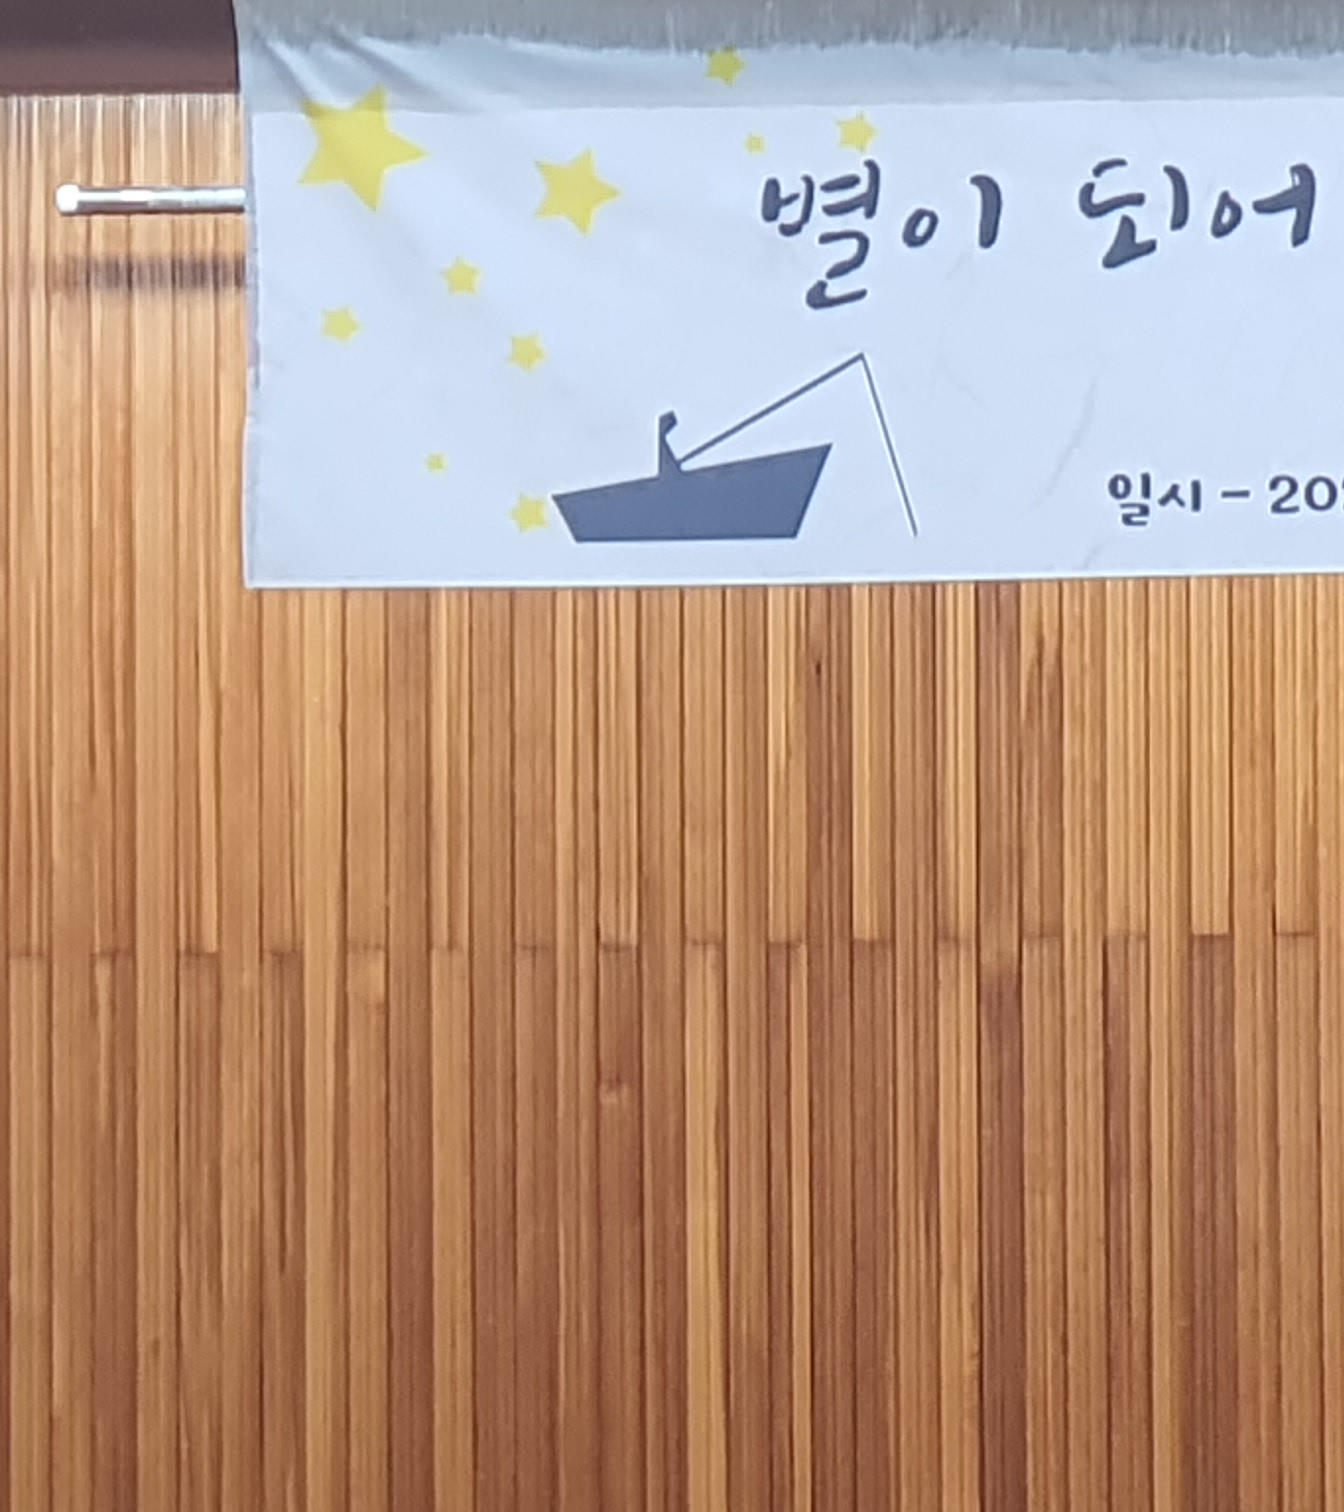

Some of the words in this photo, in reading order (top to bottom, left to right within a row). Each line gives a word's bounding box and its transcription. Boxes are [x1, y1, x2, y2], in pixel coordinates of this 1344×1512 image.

[761, 158, 1003, 311] 별이
[1078, 157, 1317, 270] 되어
[1107, 471, 1202, 527] 일시
